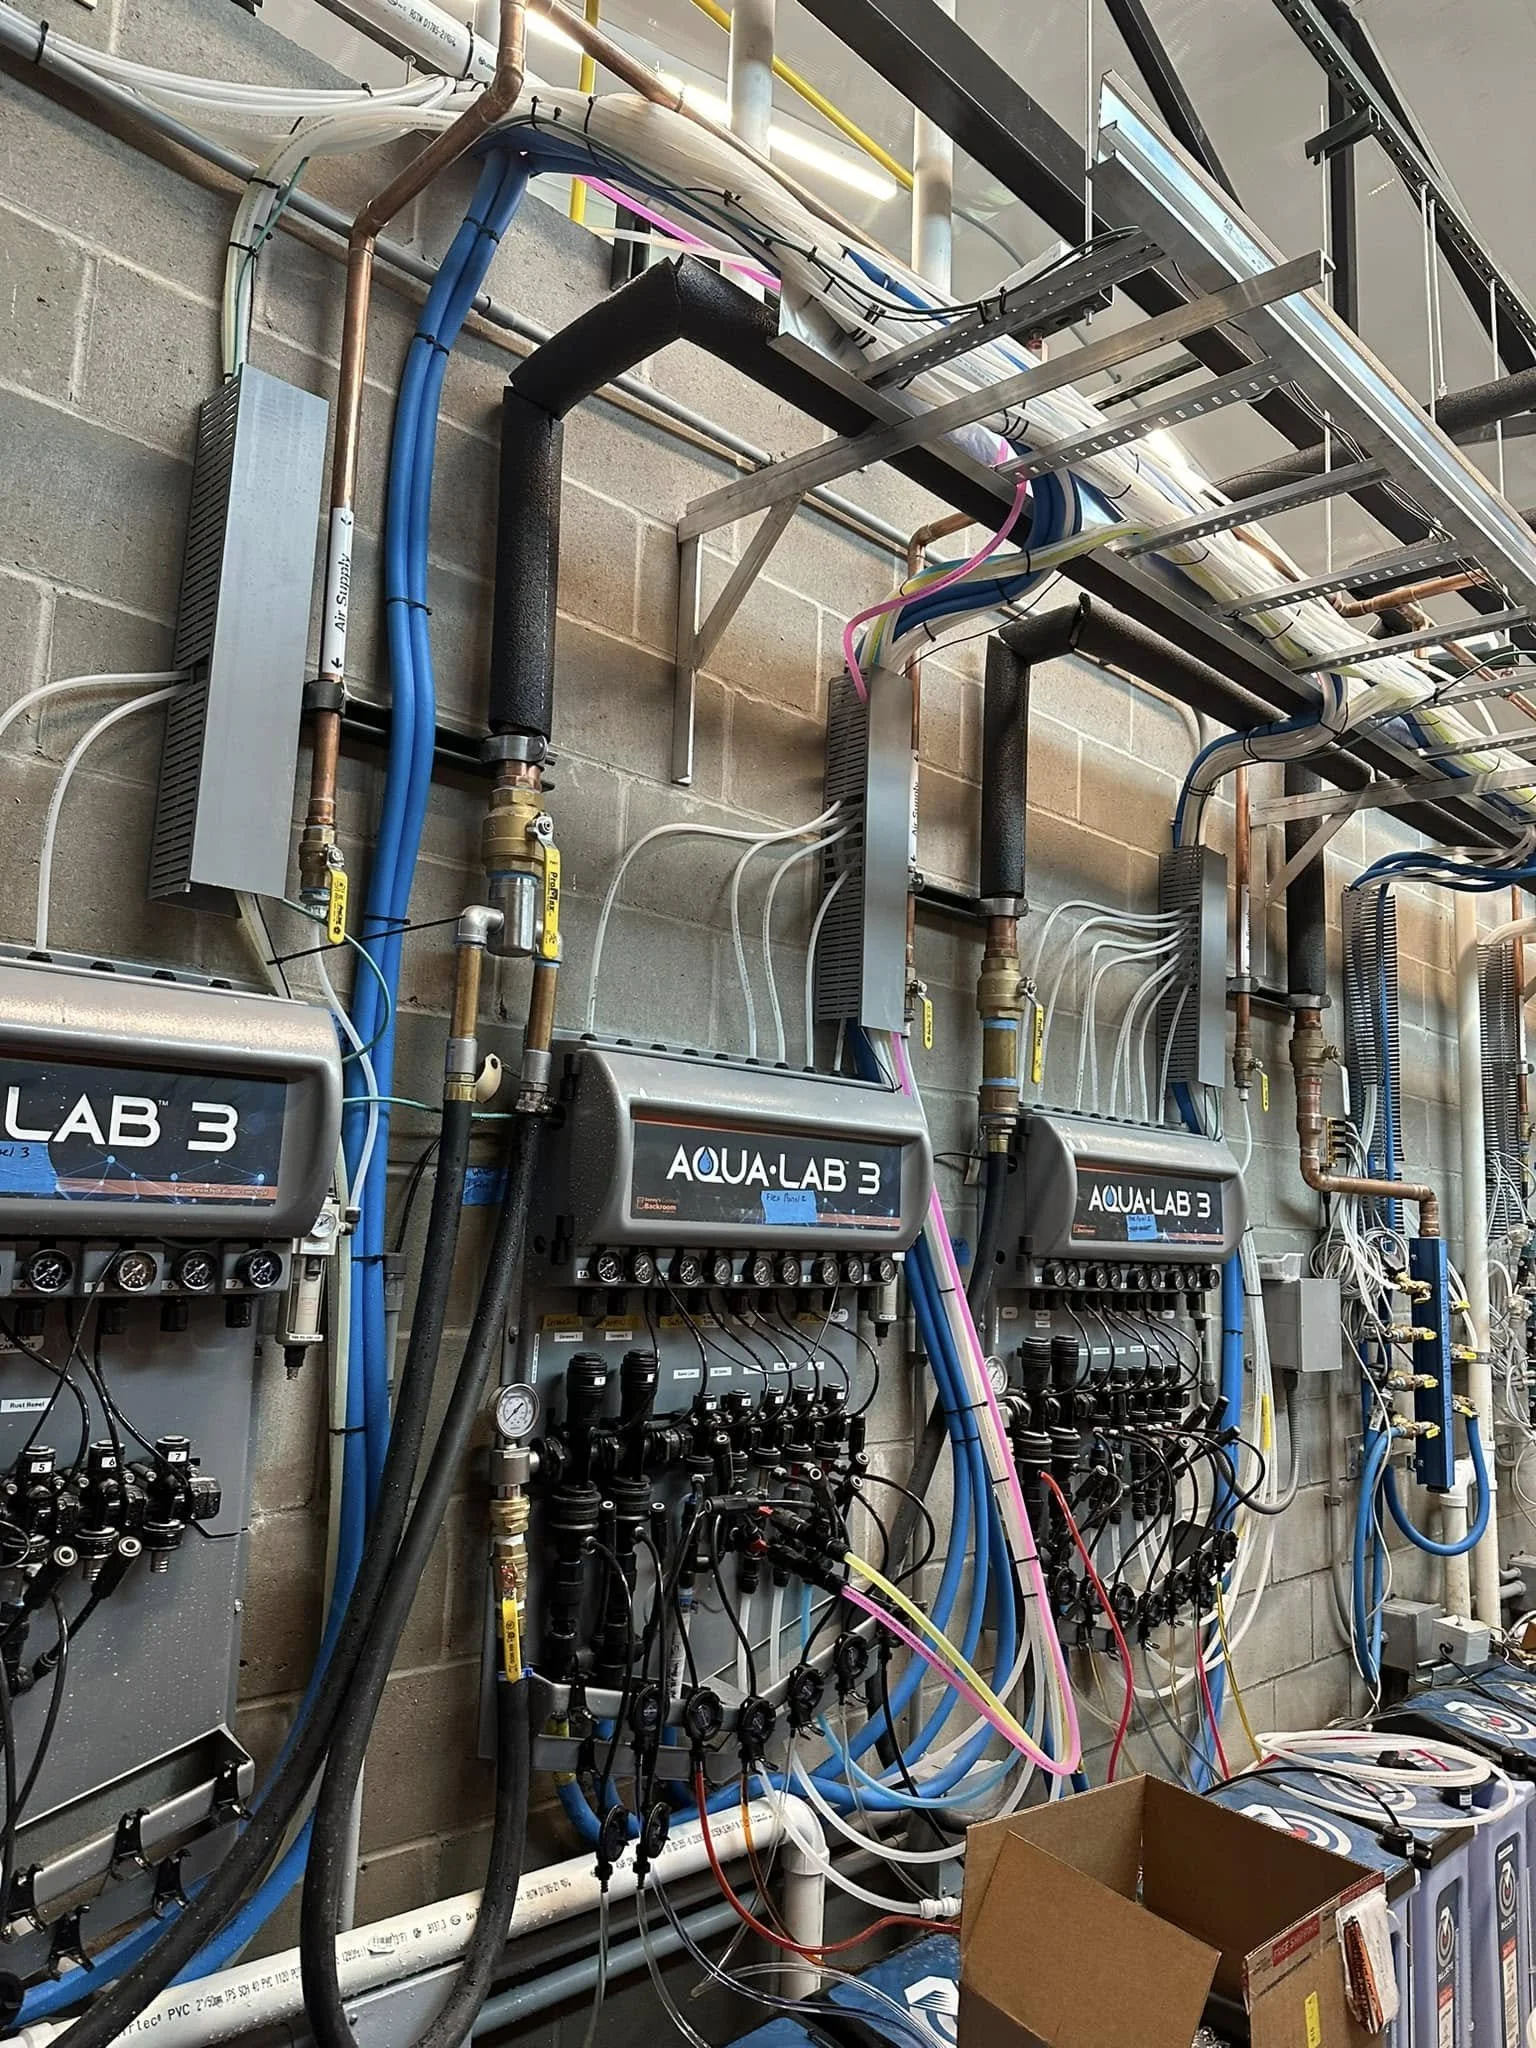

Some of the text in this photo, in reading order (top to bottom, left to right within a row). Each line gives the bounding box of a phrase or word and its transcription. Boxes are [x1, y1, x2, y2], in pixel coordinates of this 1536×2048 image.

[334, 553, 351, 633] Air Supply
[187, 1101, 239, 1152] 3
[19, 1146, 30, 1158] 3
[857, 1161, 881, 1195] 3
[1196, 1192, 1211, 1218] 3
[38, 1463, 45, 1472] 5
[168, 2003, 191, 2021] PVC
